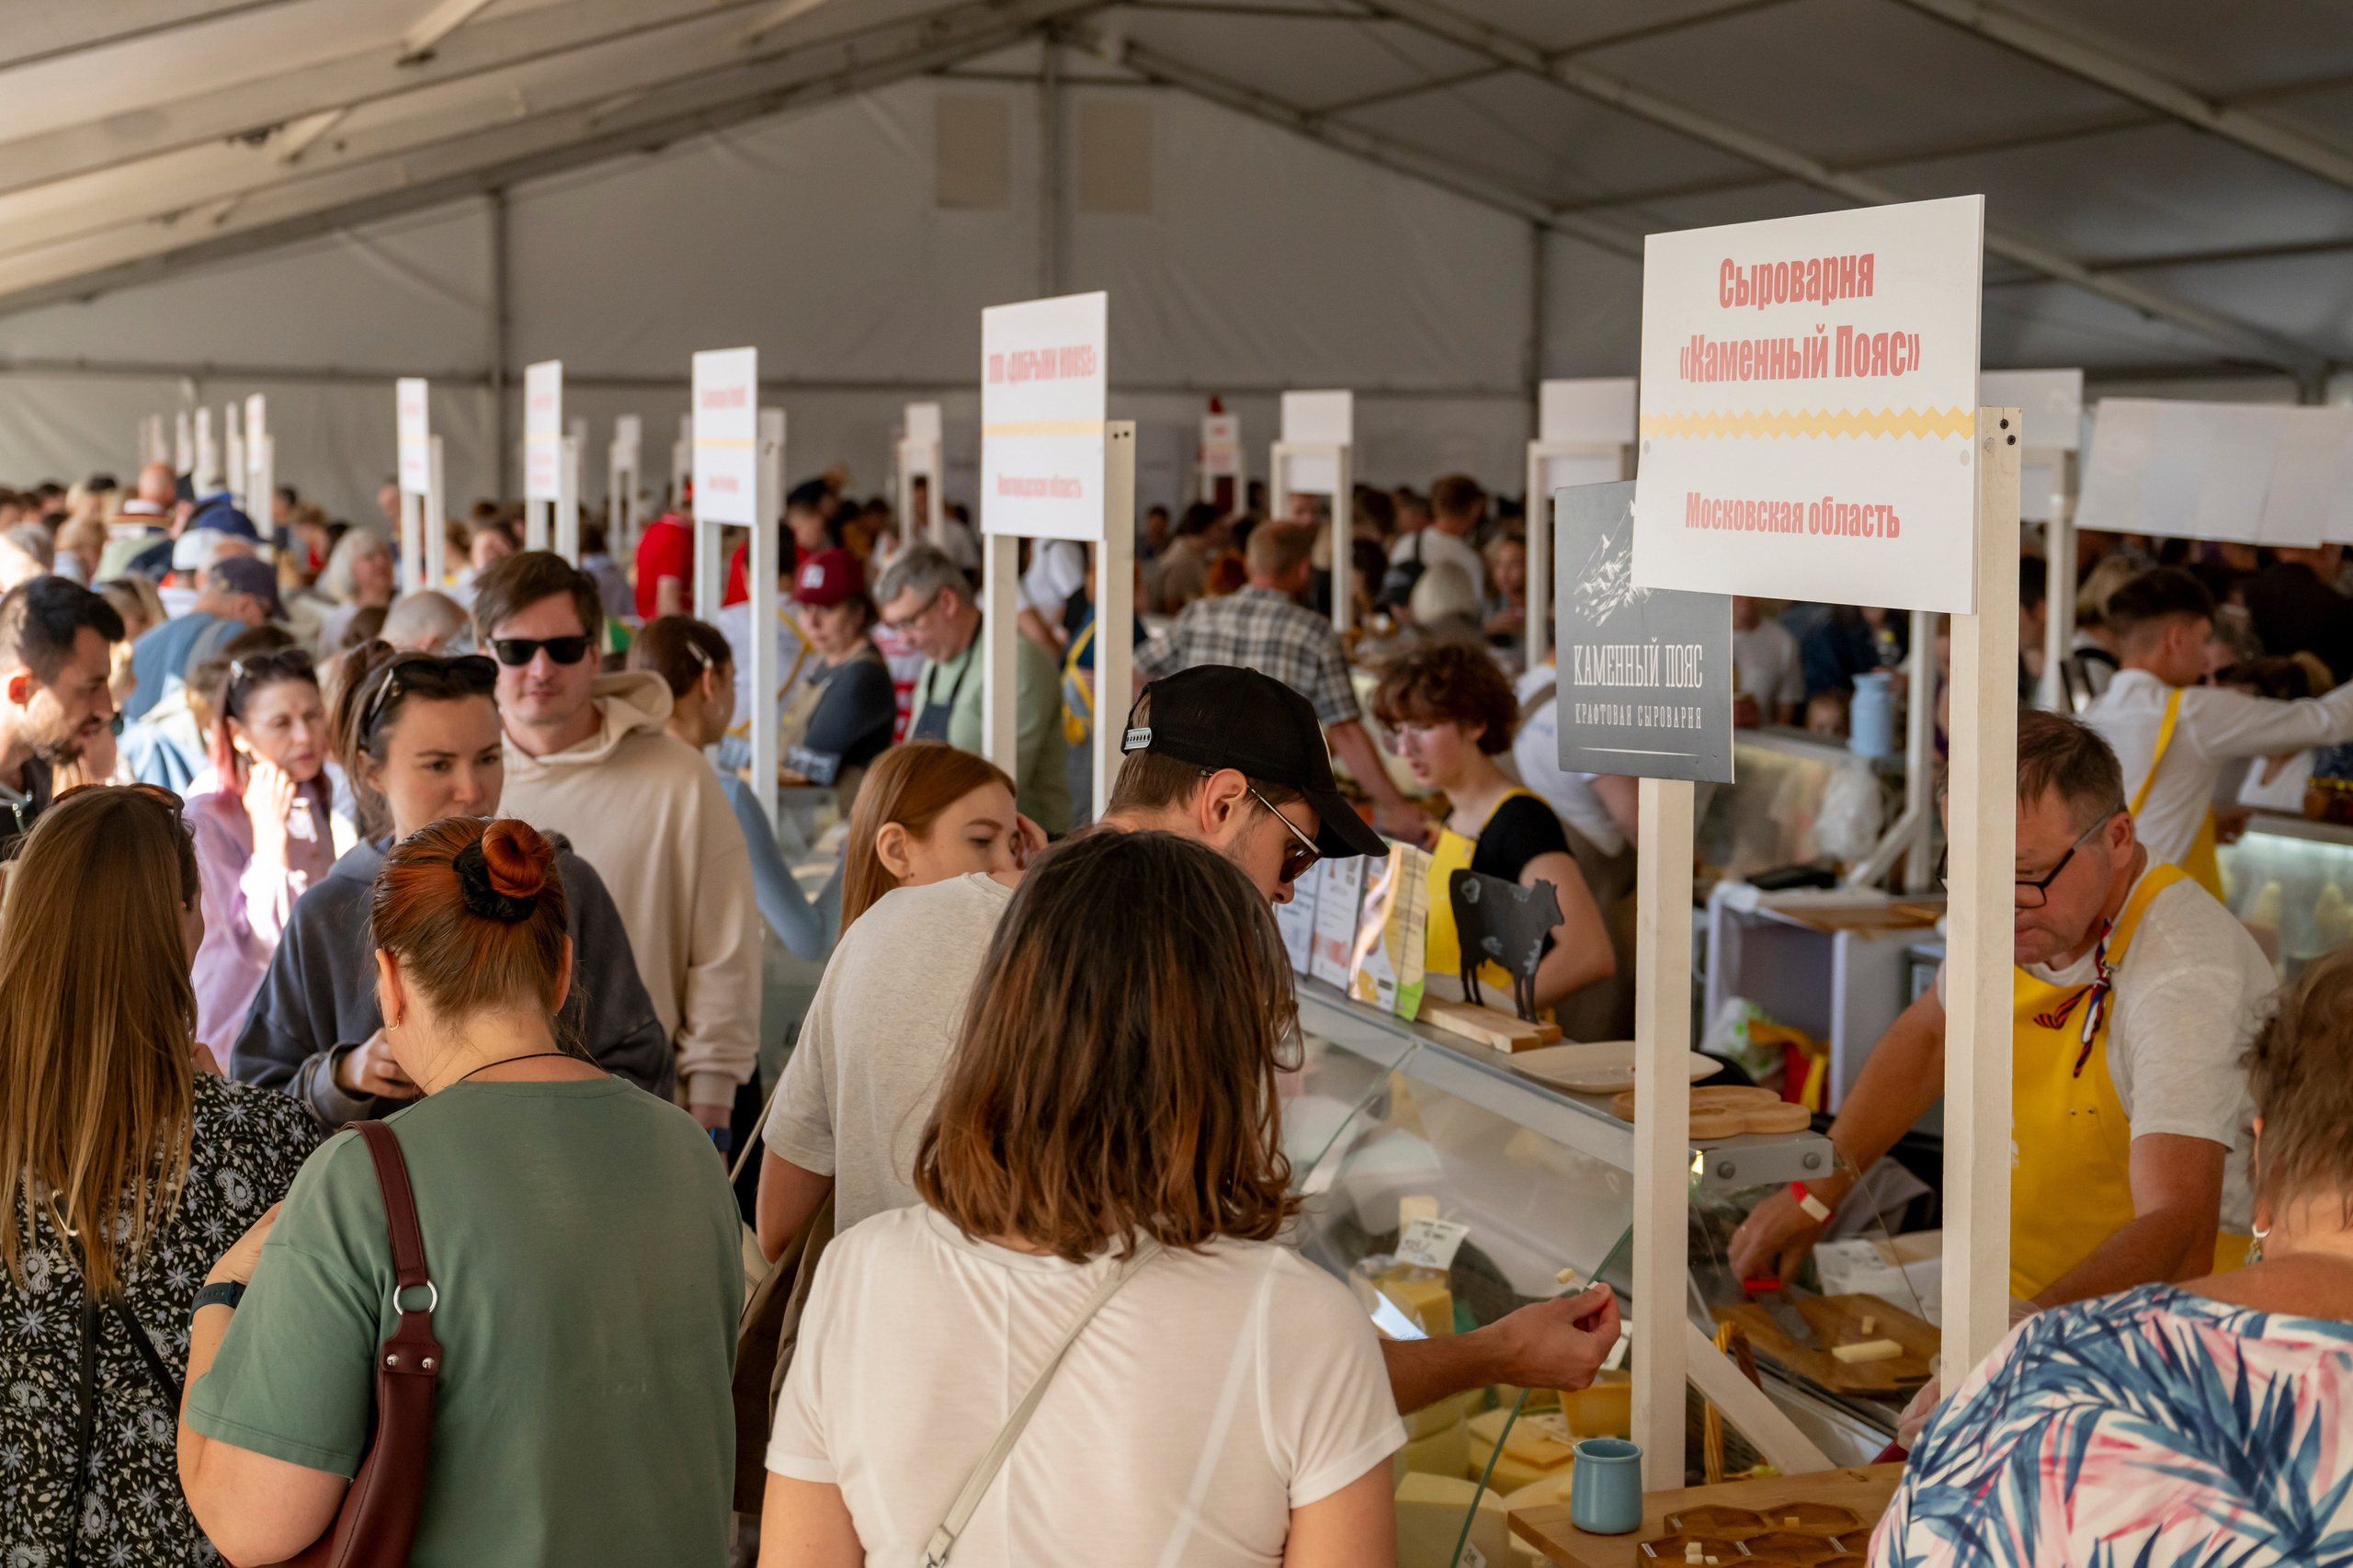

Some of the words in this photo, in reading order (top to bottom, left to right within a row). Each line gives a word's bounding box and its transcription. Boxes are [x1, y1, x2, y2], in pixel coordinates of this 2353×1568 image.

[1719, 252, 1876, 312] Сыроварня
[1678, 323, 1829, 384] «Каменный
[1834, 324, 1921, 379] Пояс»
[1685, 491, 1805, 535] Московская
[1808, 495, 1901, 540] область
[1573, 636, 1660, 687] КАМЕННЫЙ
[1665, 643, 1703, 689] ПОЯС
[1574, 702, 1632, 727] КРАФТОВАЯ
[1637, 704, 1702, 729] СЫРОВАРНЯ
